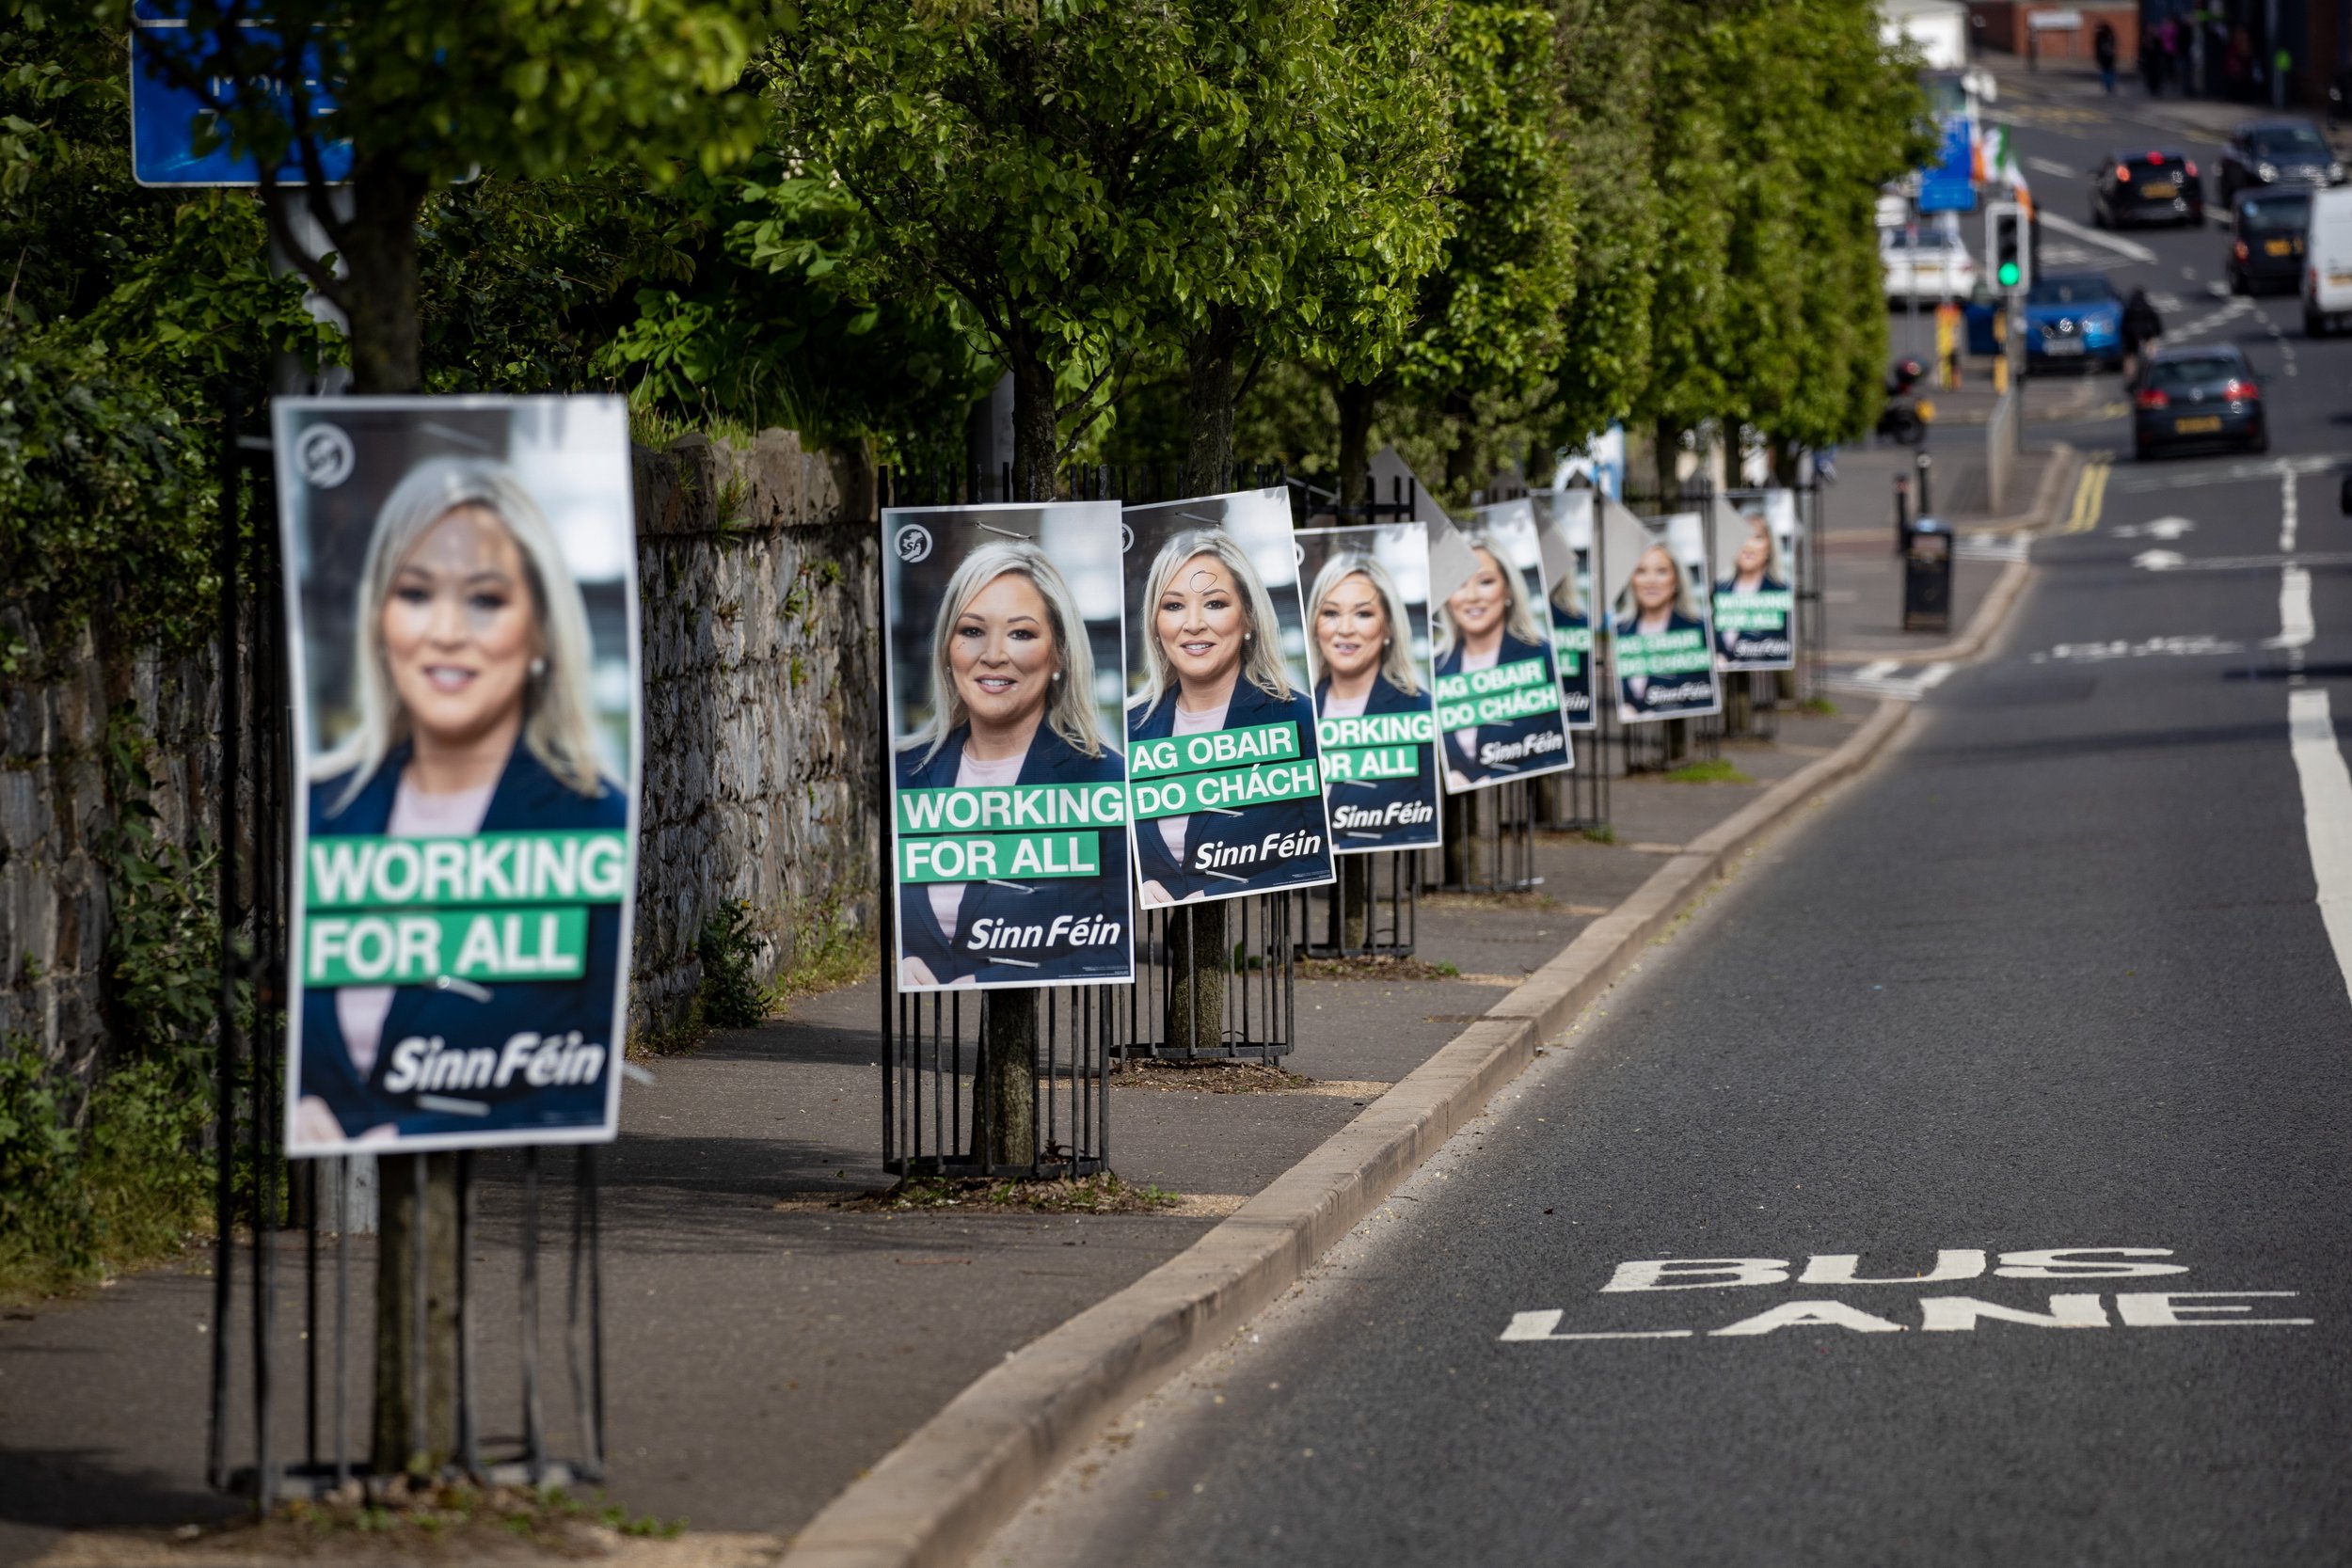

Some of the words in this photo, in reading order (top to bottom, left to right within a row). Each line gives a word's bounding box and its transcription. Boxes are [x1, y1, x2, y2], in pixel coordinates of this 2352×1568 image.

[1437, 675, 1470, 702] AG
[1471, 660, 1543, 693] OBAIR
[1441, 703, 1475, 729] DO
[1478, 684, 1560, 721] CHÁCH
[1132, 741, 1178, 773] AG
[1187, 727, 1293, 765] OBAIR
[1318, 714, 1433, 746] ORKING
[1479, 740, 1523, 766] Sinn
[1522, 730, 1564, 757] Féin
[1359, 749, 1416, 777] ALL
[901, 786, 1125, 830] WORKING
[1136, 783, 1186, 815] DO
[1196, 763, 1316, 805] CHÁCH
[1331, 805, 1384, 829] Sinn
[1383, 800, 1434, 825] Féin
[309, 834, 625, 905] WORKING
[905, 840, 997, 879] FOR
[1009, 836, 1095, 875] ALL
[1195, 841, 1257, 870] Sinn
[1259, 830, 1321, 861] Féin
[308, 916, 444, 980] FOR
[453, 912, 579, 975] ALL
[966, 917, 1044, 951] Sinn
[1045, 913, 1121, 947] Féin
[382, 1036, 498, 1093] Sinn
[492, 1029, 606, 1087] Féin
[1598, 1248, 2189, 1292] BUS
[1499, 1291, 2315, 1340] LANE
